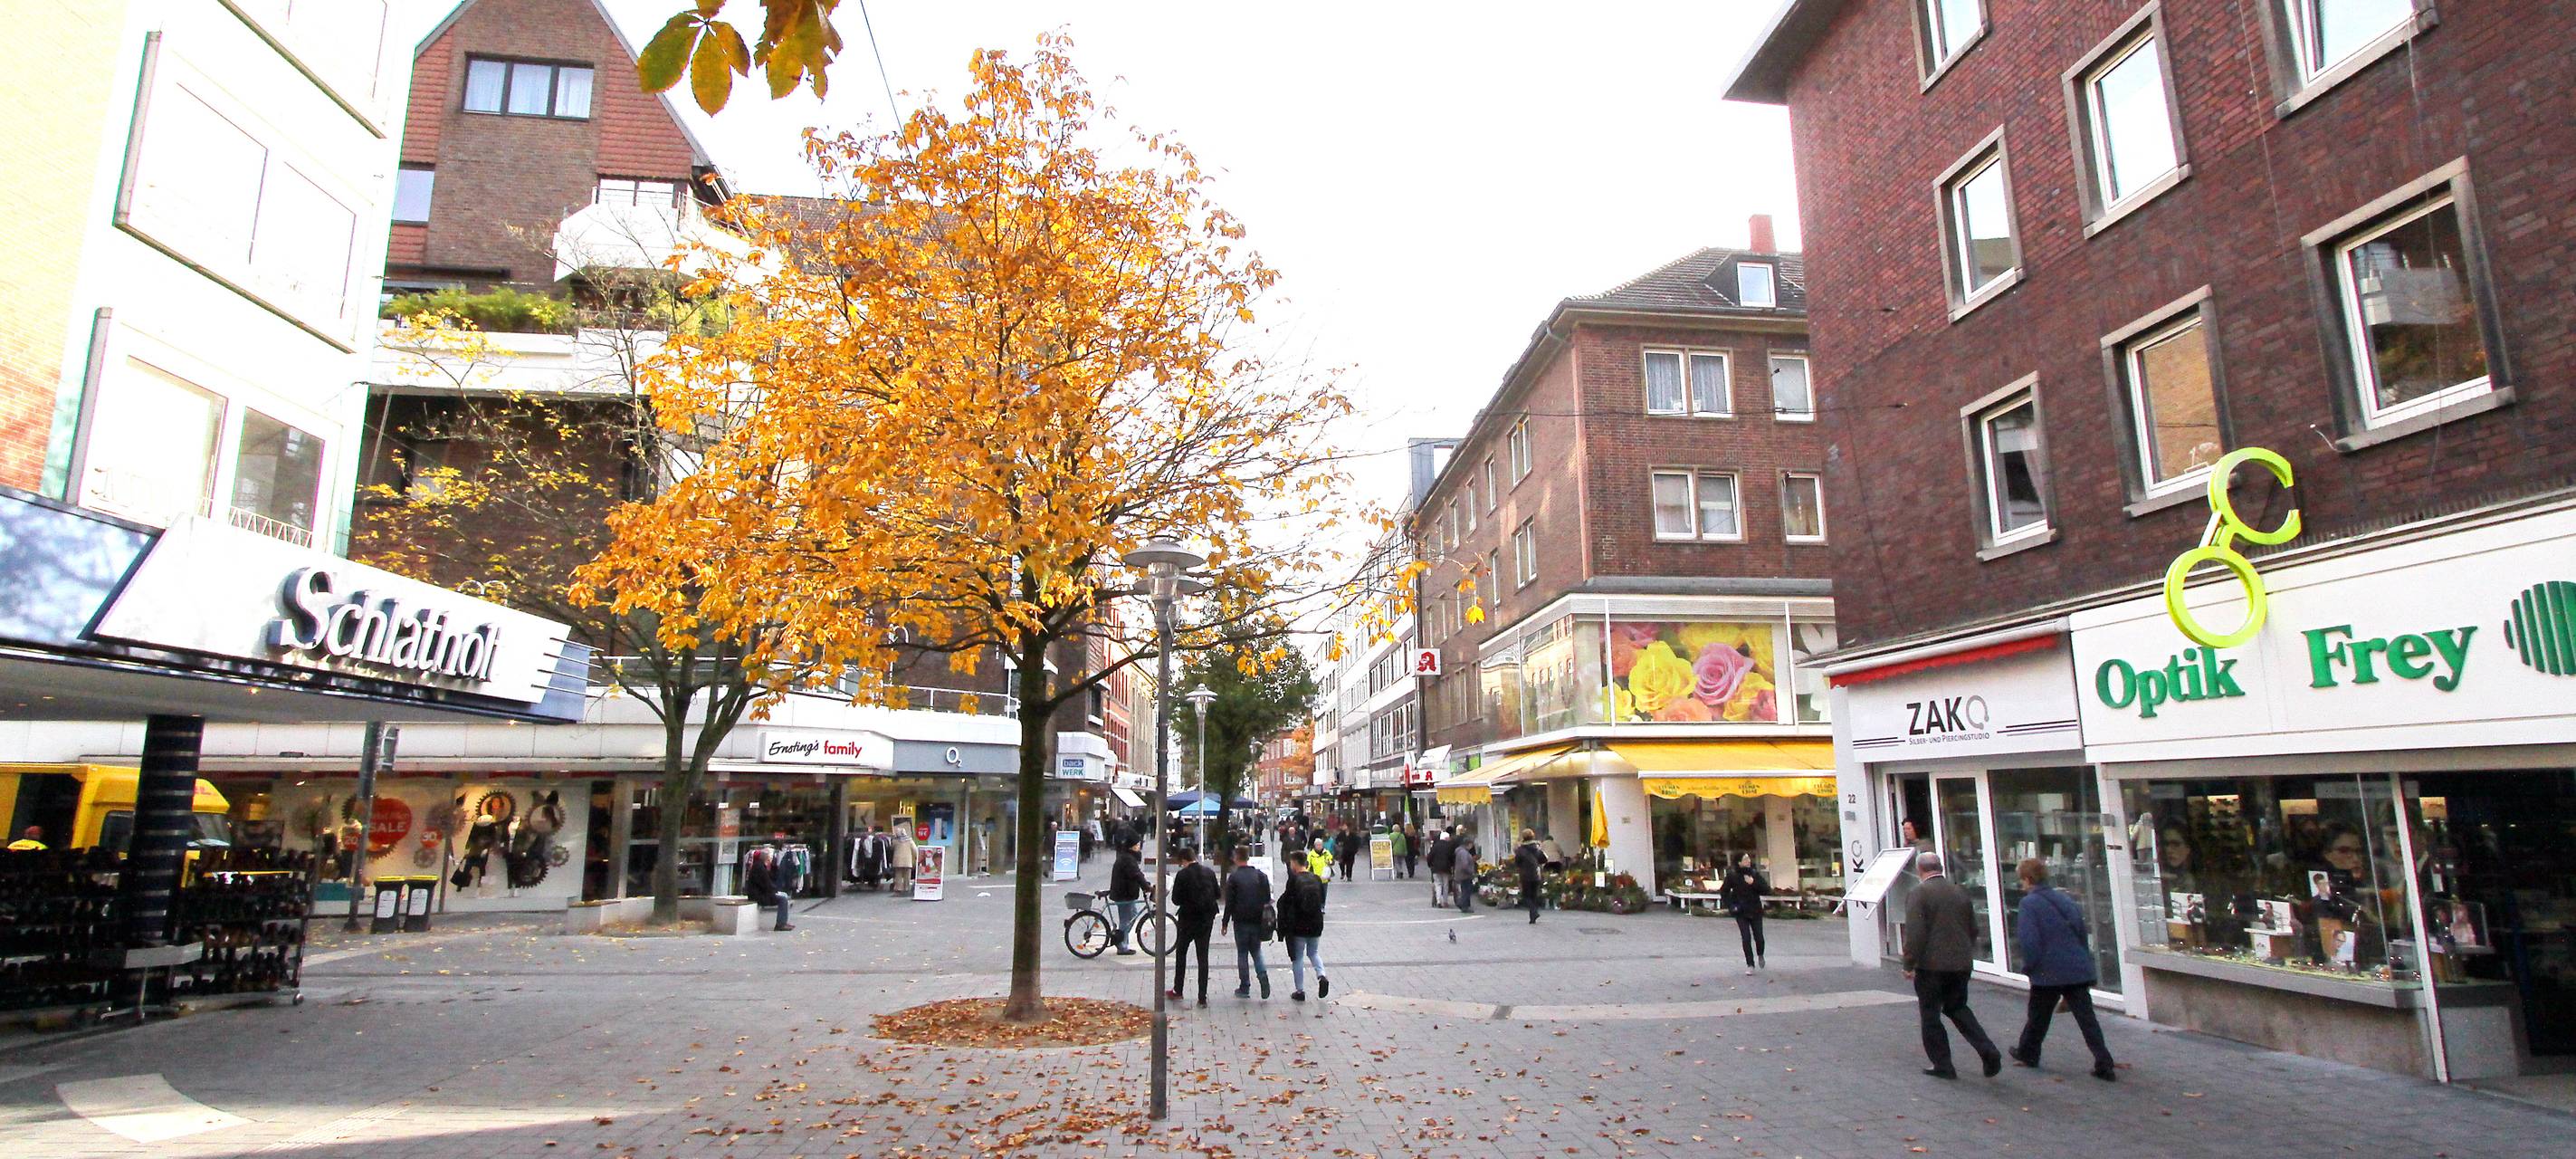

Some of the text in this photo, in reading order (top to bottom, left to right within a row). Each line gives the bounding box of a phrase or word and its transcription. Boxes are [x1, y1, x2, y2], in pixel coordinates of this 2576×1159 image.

[2094, 624, 2478, 719] Optik Frey
[768, 740, 862, 759] Ernsting's family
[1848, 794, 1856, 804] 22
[368, 822, 406, 832] SALE
